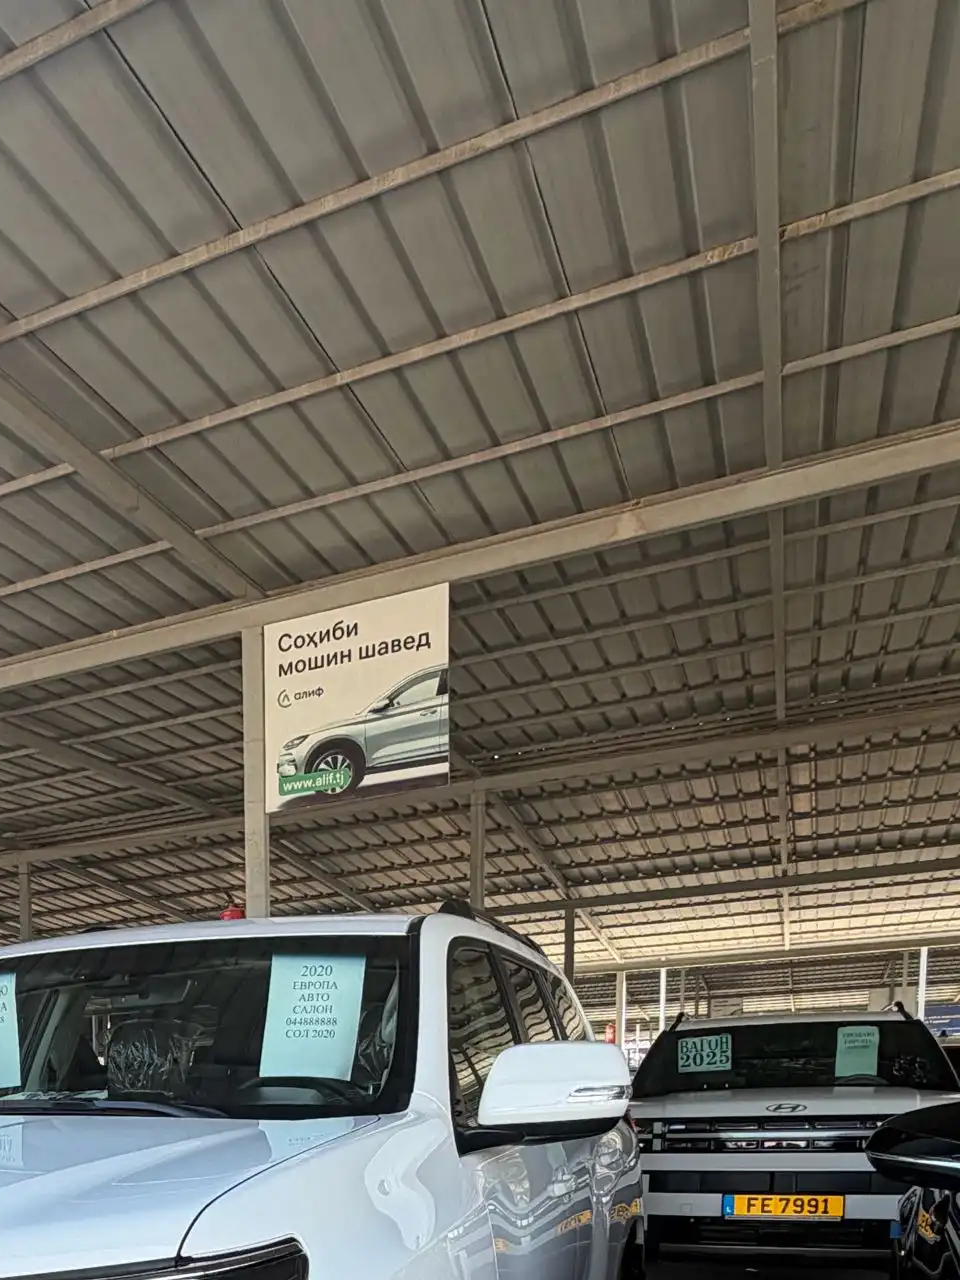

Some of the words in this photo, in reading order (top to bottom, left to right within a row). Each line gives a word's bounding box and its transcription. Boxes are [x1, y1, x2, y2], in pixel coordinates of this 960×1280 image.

[278, 620, 359, 653] Соҳиби
[278, 649, 352, 678] мошин
[358, 631, 431, 660] шавед
[293, 686, 324, 702] алиф
[282, 769, 344, 793] www.alif.tj
[301, 964, 333, 977] 2020
[293, 980, 338, 990] ЕВРОПА
[298, 992, 330, 1002] АВТО
[292, 1004, 333, 1014] САЛОН
[285, 1029, 309, 1038] СОЛ
[311, 1029, 336, 1039] 2020
[680, 1035, 730, 1054] ВАГОН
[680, 1050, 730, 1068] 2025
[746, 1197, 773, 1214] FE
[778, 1197, 829, 1215] 7991
